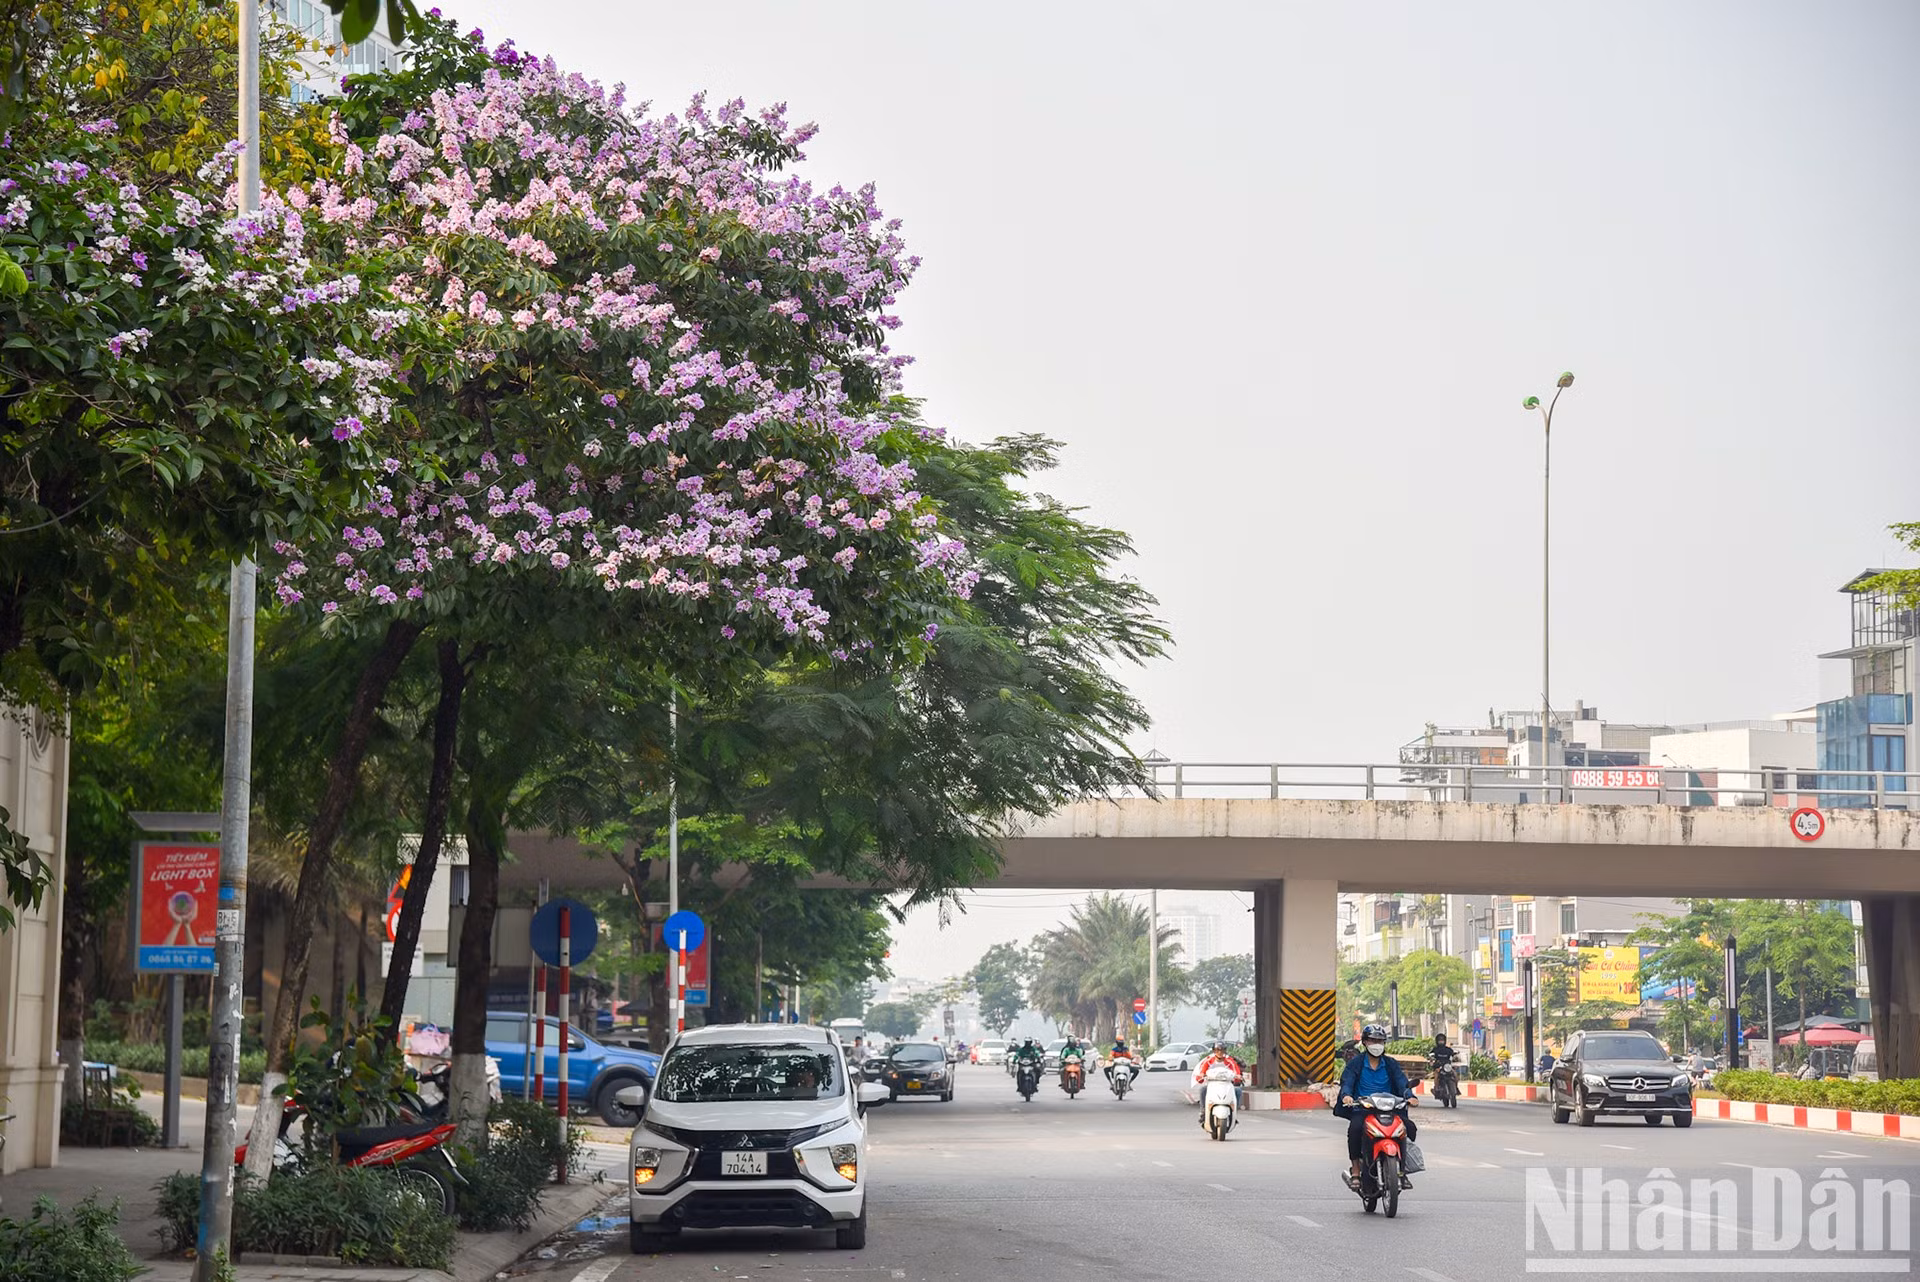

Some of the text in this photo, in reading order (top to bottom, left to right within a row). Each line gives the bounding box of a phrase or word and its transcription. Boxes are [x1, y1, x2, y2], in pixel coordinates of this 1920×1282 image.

[1573, 770, 1604, 786] 0988
[1608, 770, 1623, 786] 59
[1627, 770, 1643, 786] 55
[165, 852, 209, 863] TIẾT KIỆM
[150, 868, 214, 881] LIGHT BOX
[736, 1153, 753, 1162] 14A
[726, 1164, 762, 1173] 704.14
